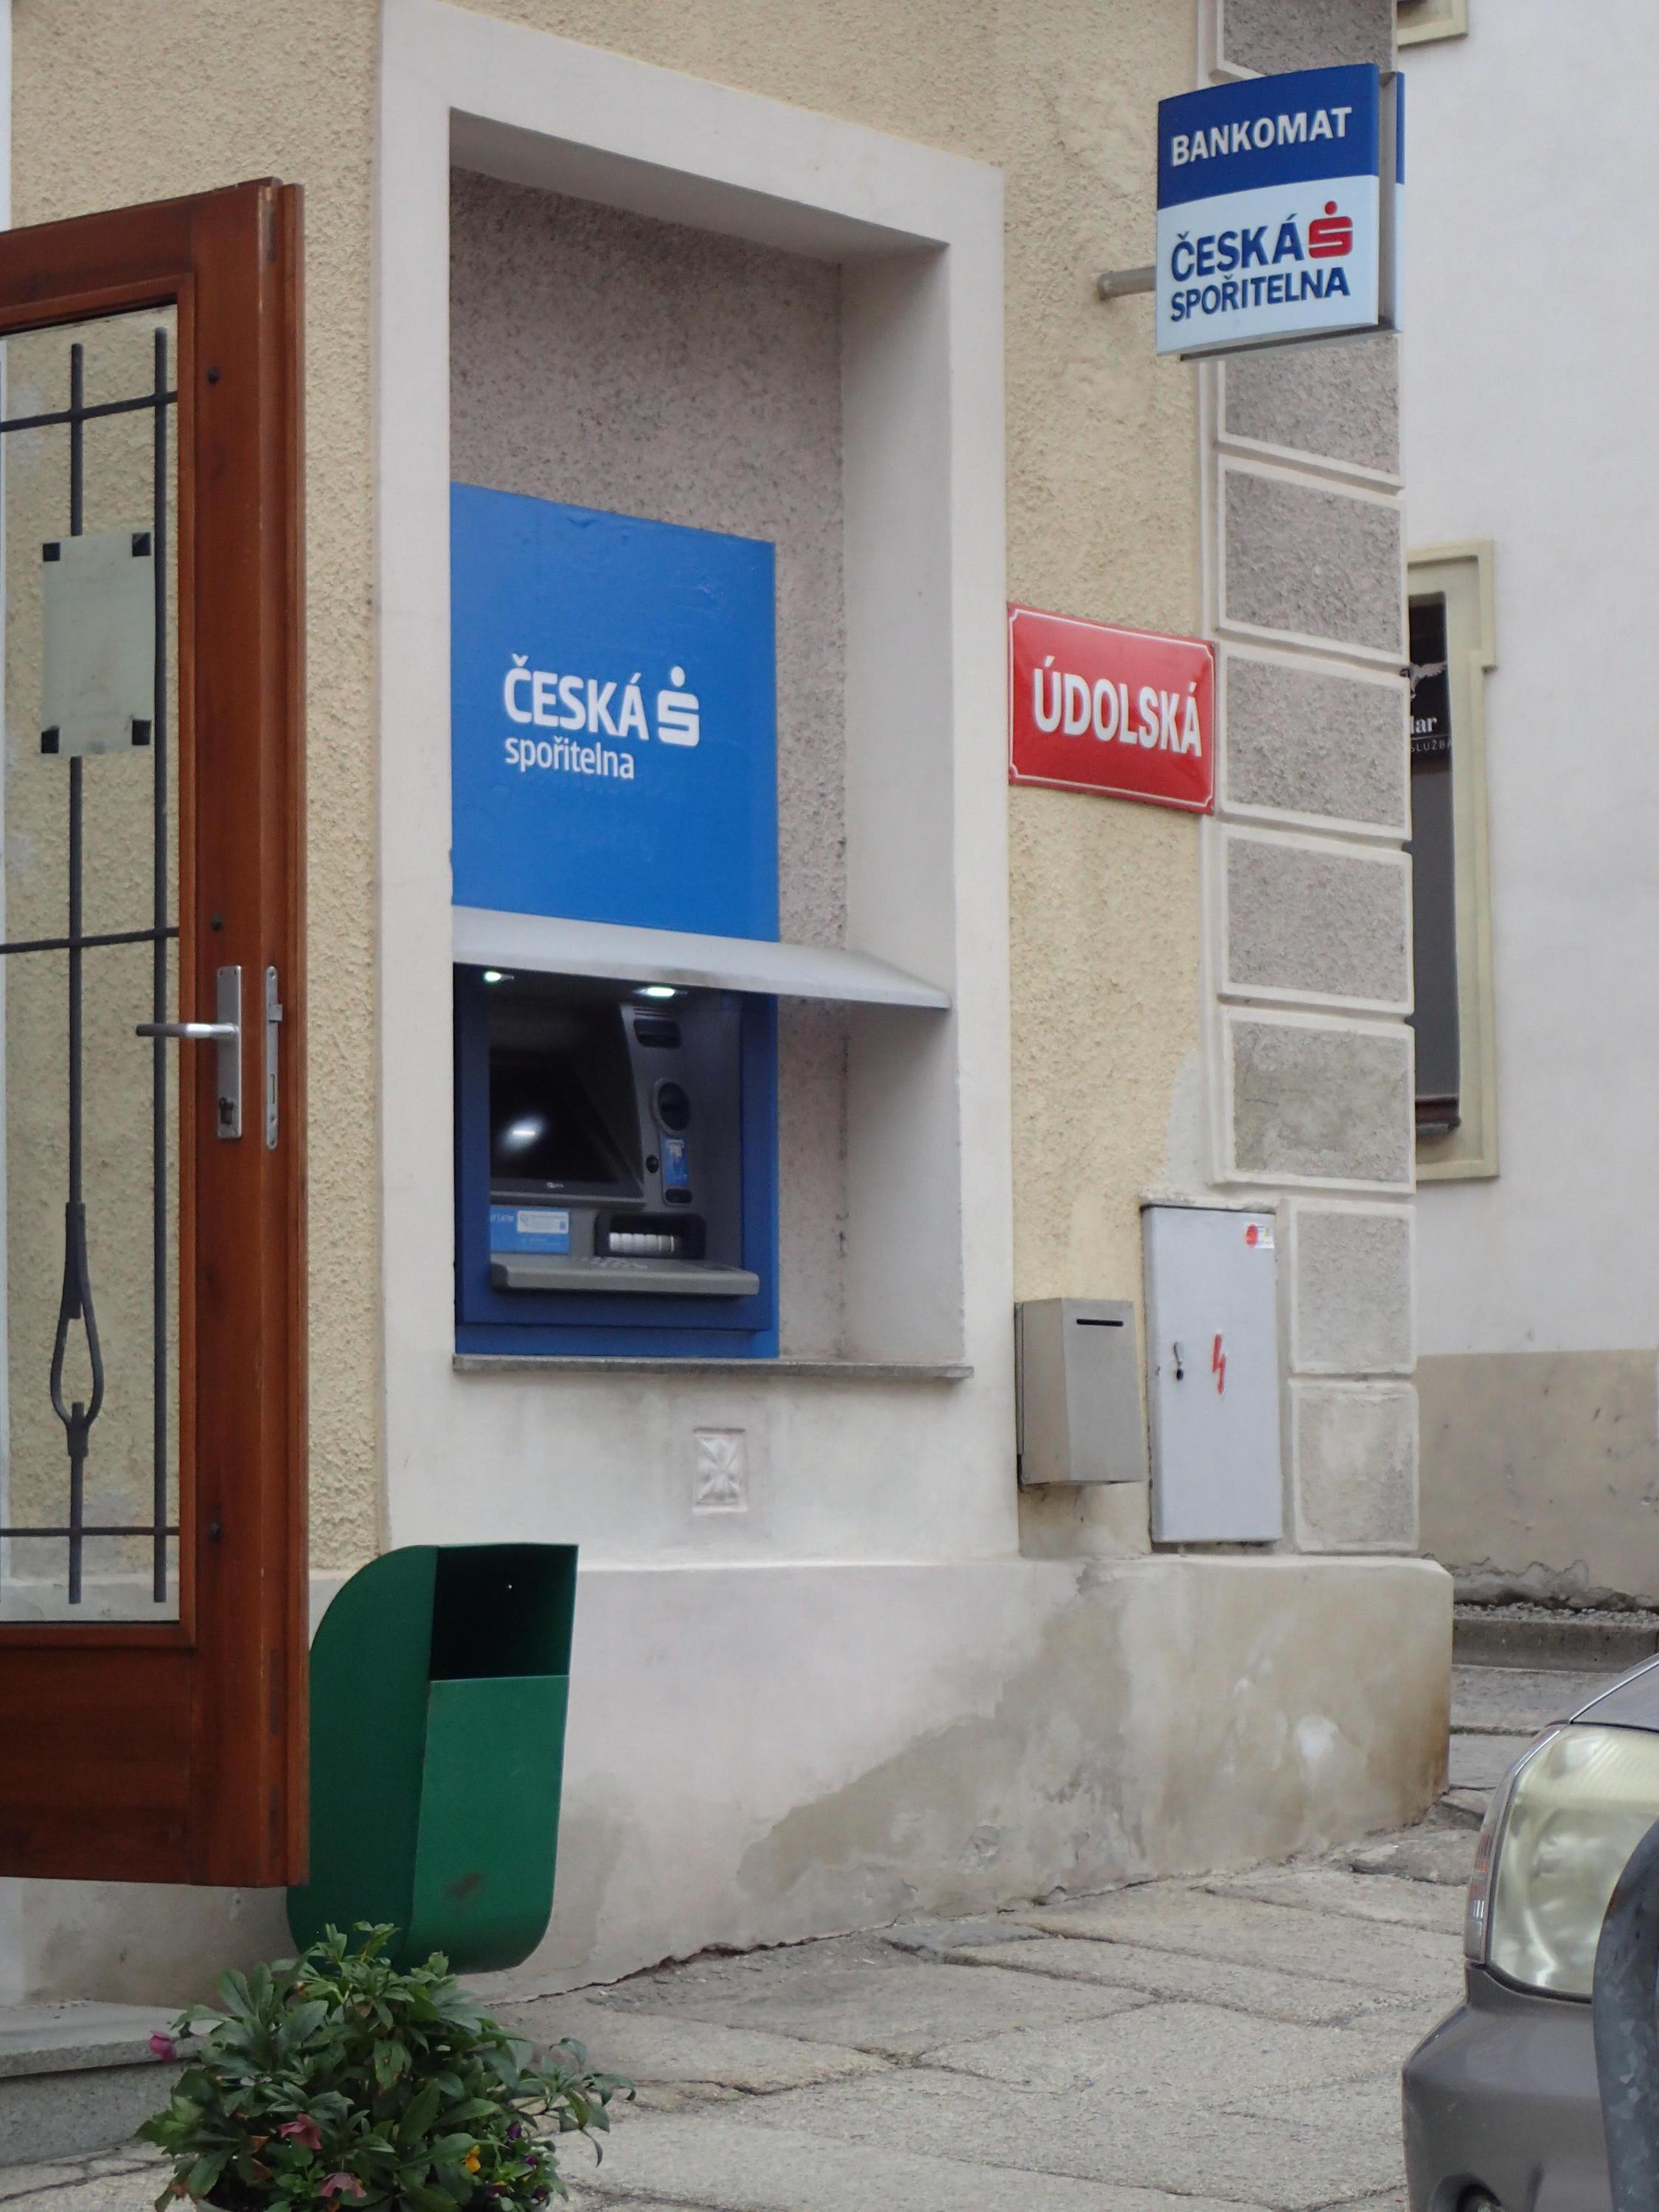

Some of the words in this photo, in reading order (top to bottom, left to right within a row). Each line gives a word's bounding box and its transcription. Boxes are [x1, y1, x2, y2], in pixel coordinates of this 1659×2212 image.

[1171, 106, 1352, 167] BANKOMAT
[1171, 213, 1305, 283] ČESKÁ
[1170, 266, 1351, 322] SPOŘITELNA
[504, 653, 650, 741] ČESKÁ
[1034, 655, 1203, 758] ÚDOLSKÁ
[504, 736, 635, 780] spořitelna
